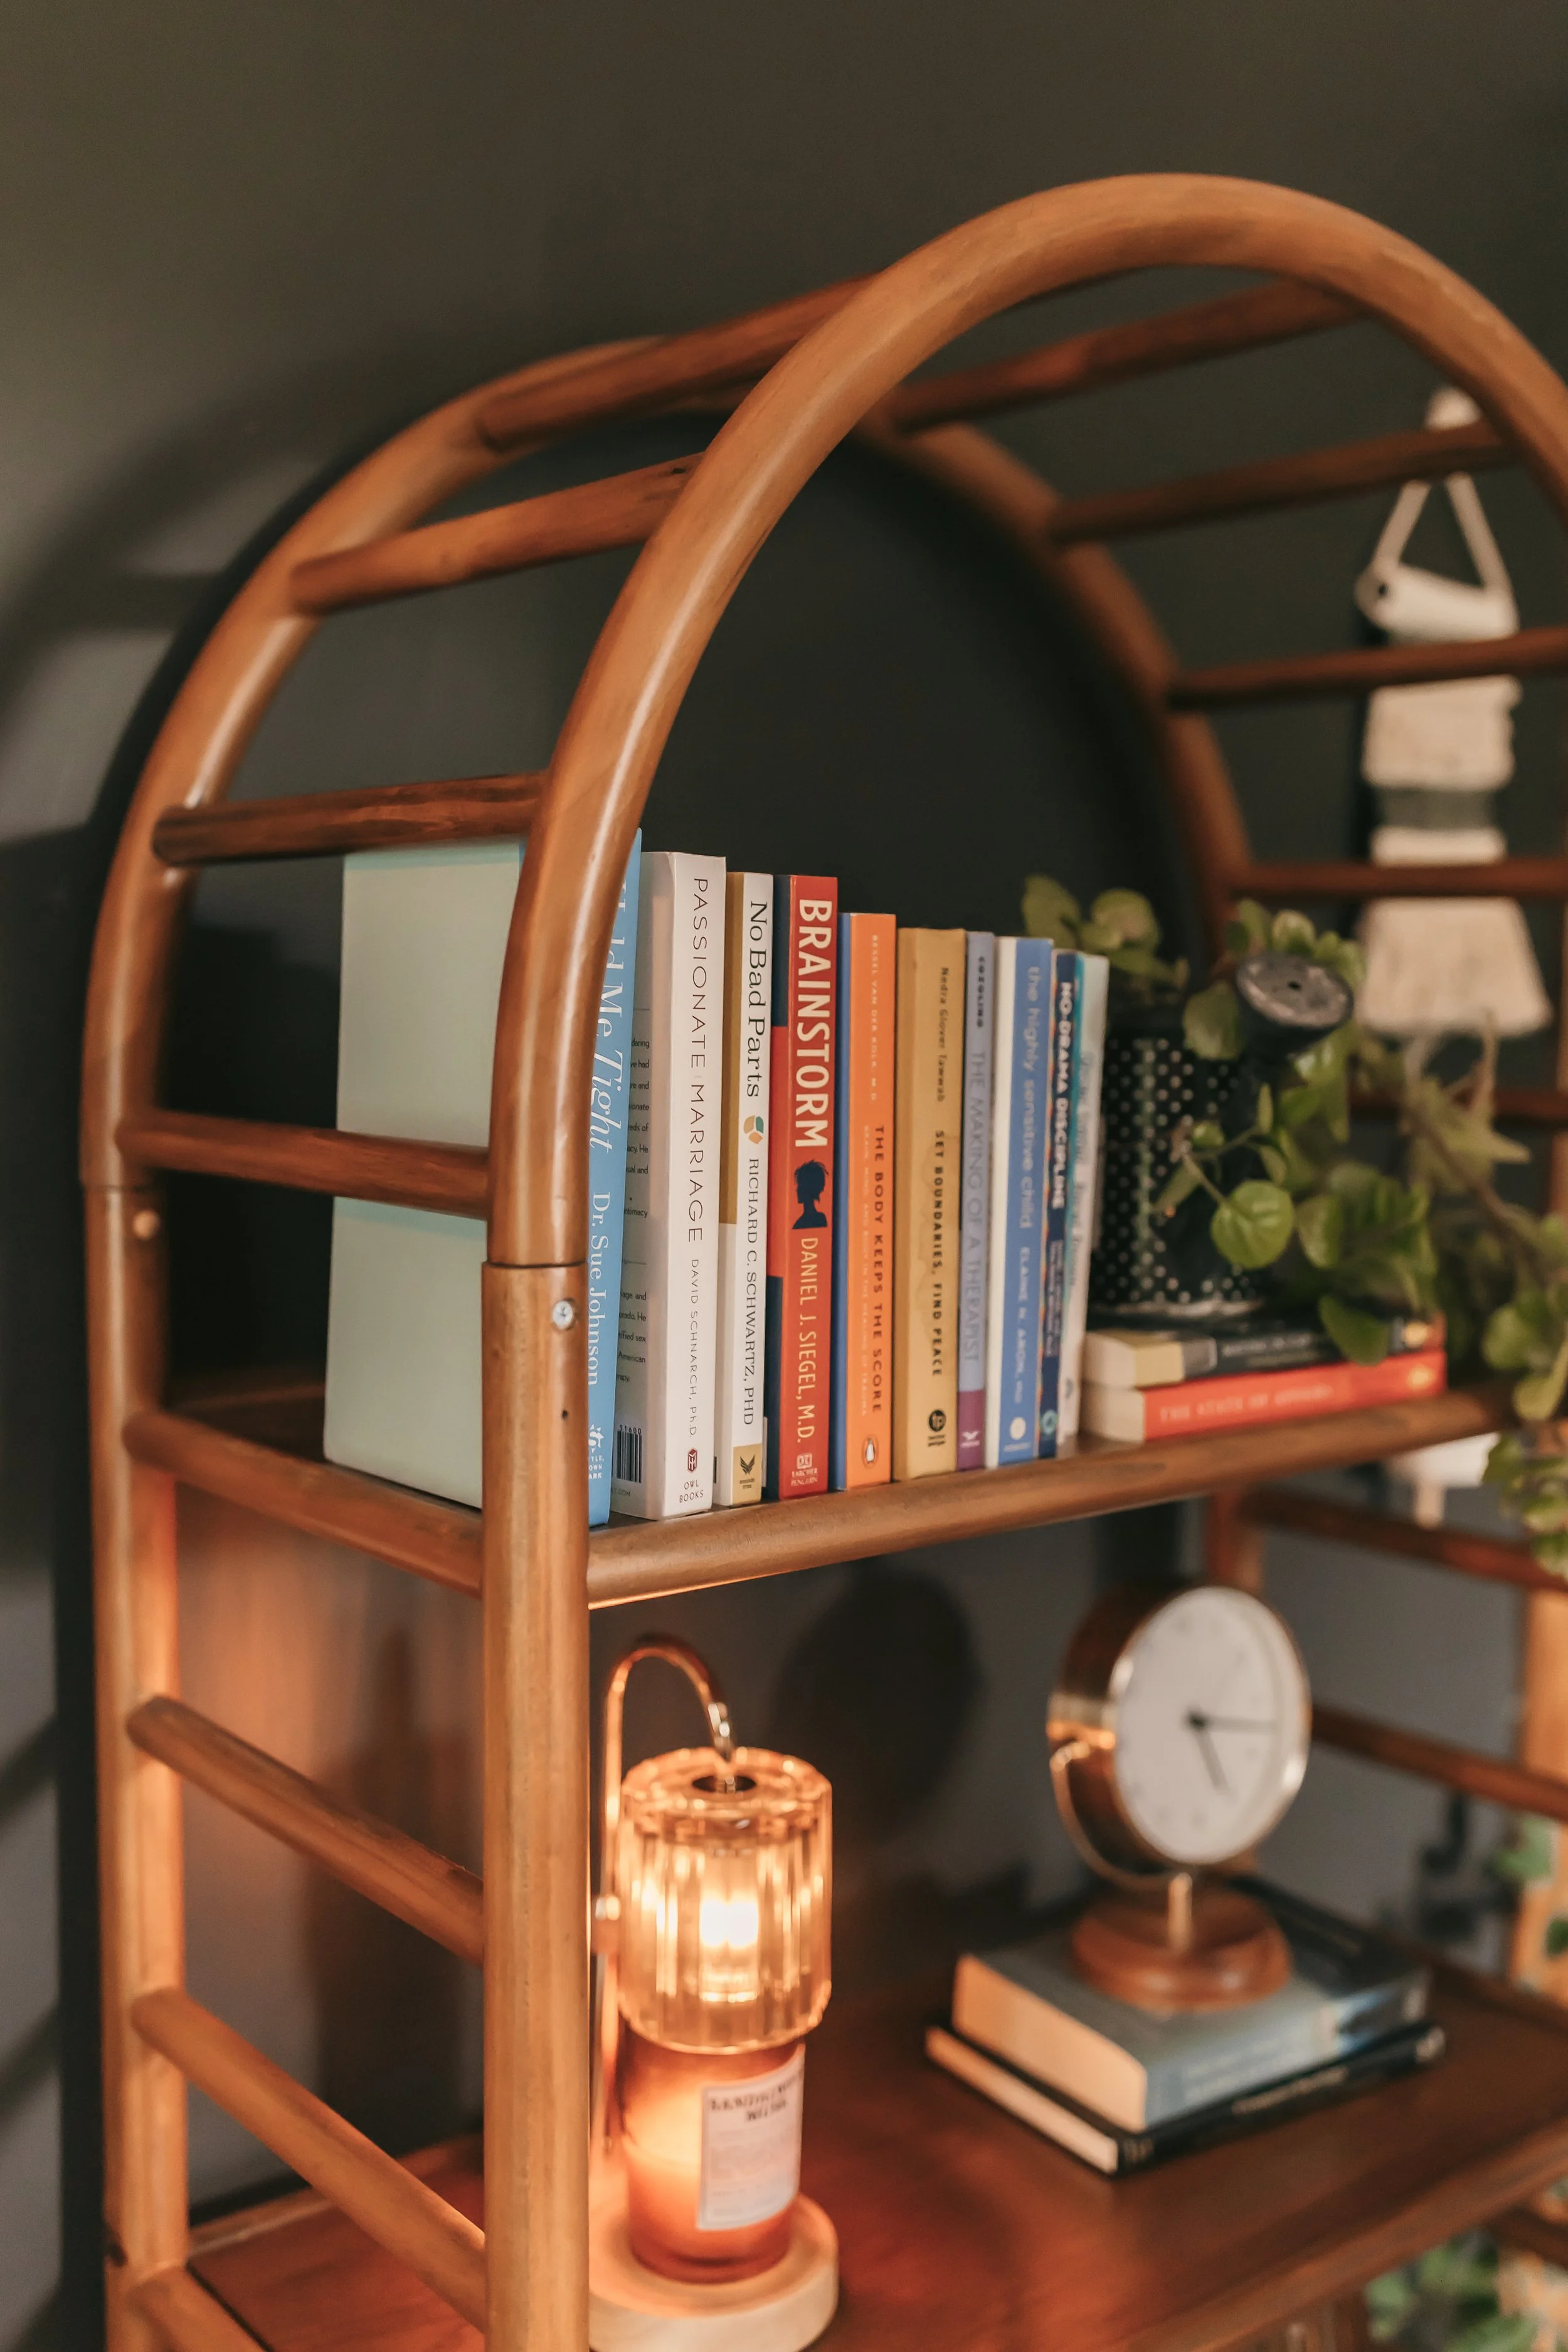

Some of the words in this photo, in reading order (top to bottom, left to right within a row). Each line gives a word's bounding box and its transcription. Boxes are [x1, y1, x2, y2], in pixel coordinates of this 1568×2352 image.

[750, 901, 768, 941] No
[691, 878, 709, 1068] PASSIONATE
[748, 948, 767, 1007] Bad
[1027, 966, 1040, 1001] the
[596, 982, 624, 1037] Me
[795, 898, 833, 1148] BRAINSTORM
[747, 1016, 766, 1098] Parts
[1023, 1007, 1040, 1071] highly
[638, 1059, 650, 1068] had
[972, 1053, 985, 1084] THE
[589, 1049, 623, 1153] Tight
[638, 1081, 650, 1089] and
[641, 1123, 649, 1131] of
[875, 1125, 884, 1162] THE
[935, 1131, 944, 1157] SET
[967, 1096, 985, 1191] MAKING
[1022, 1079, 1036, 1172] sensitive
[639, 1143, 649, 1153] He
[689, 1084, 705, 1242] MARRIAGE
[637, 1165, 649, 1174] and
[591, 1192, 610, 1227] Dr.
[624, 1208, 648, 1218] ntimacy
[747, 1158, 759, 1244] RICHARD
[874, 1172, 884, 1224] BODY
[967, 1197, 983, 1224] OF
[1019, 1176, 1034, 1229] child
[931, 1167, 943, 1275] BOUNDARIES,
[588, 1234, 609, 1280] Sue
[746, 1250, 758, 1267] C.
[967, 1236, 981, 1251] A
[690, 1259, 700, 1304] DAVID
[799, 1237, 819, 1306] DANIEL
[873, 1234, 883, 1294] KEEPS
[635, 1292, 647, 1300] and
[637, 1311, 647, 1321] He
[933, 1283, 943, 1320] FIND
[963, 1259, 982, 1362] THERAPIST
[588, 1288, 608, 1386] Johnson
[743, 1271, 757, 1382] SCHWARTZ,
[799, 1313, 817, 1325] J.
[873, 1303, 882, 1339] THE
[688, 1311, 699, 1399] SCHNARCH,
[796, 1331, 817, 1400] SIEGEL,
[932, 1328, 943, 1375] PEACE
[872, 1348, 882, 1413] SCORE
[689, 1406, 698, 1438] Ph.D.
[743, 1387, 755, 1426] PHD
[797, 1404, 815, 1443] M.D.
[620, 1424, 642, 1435] 51600
[679, 1490, 704, 1503] BOOKS
[684, 1479, 699, 1490] OWL
